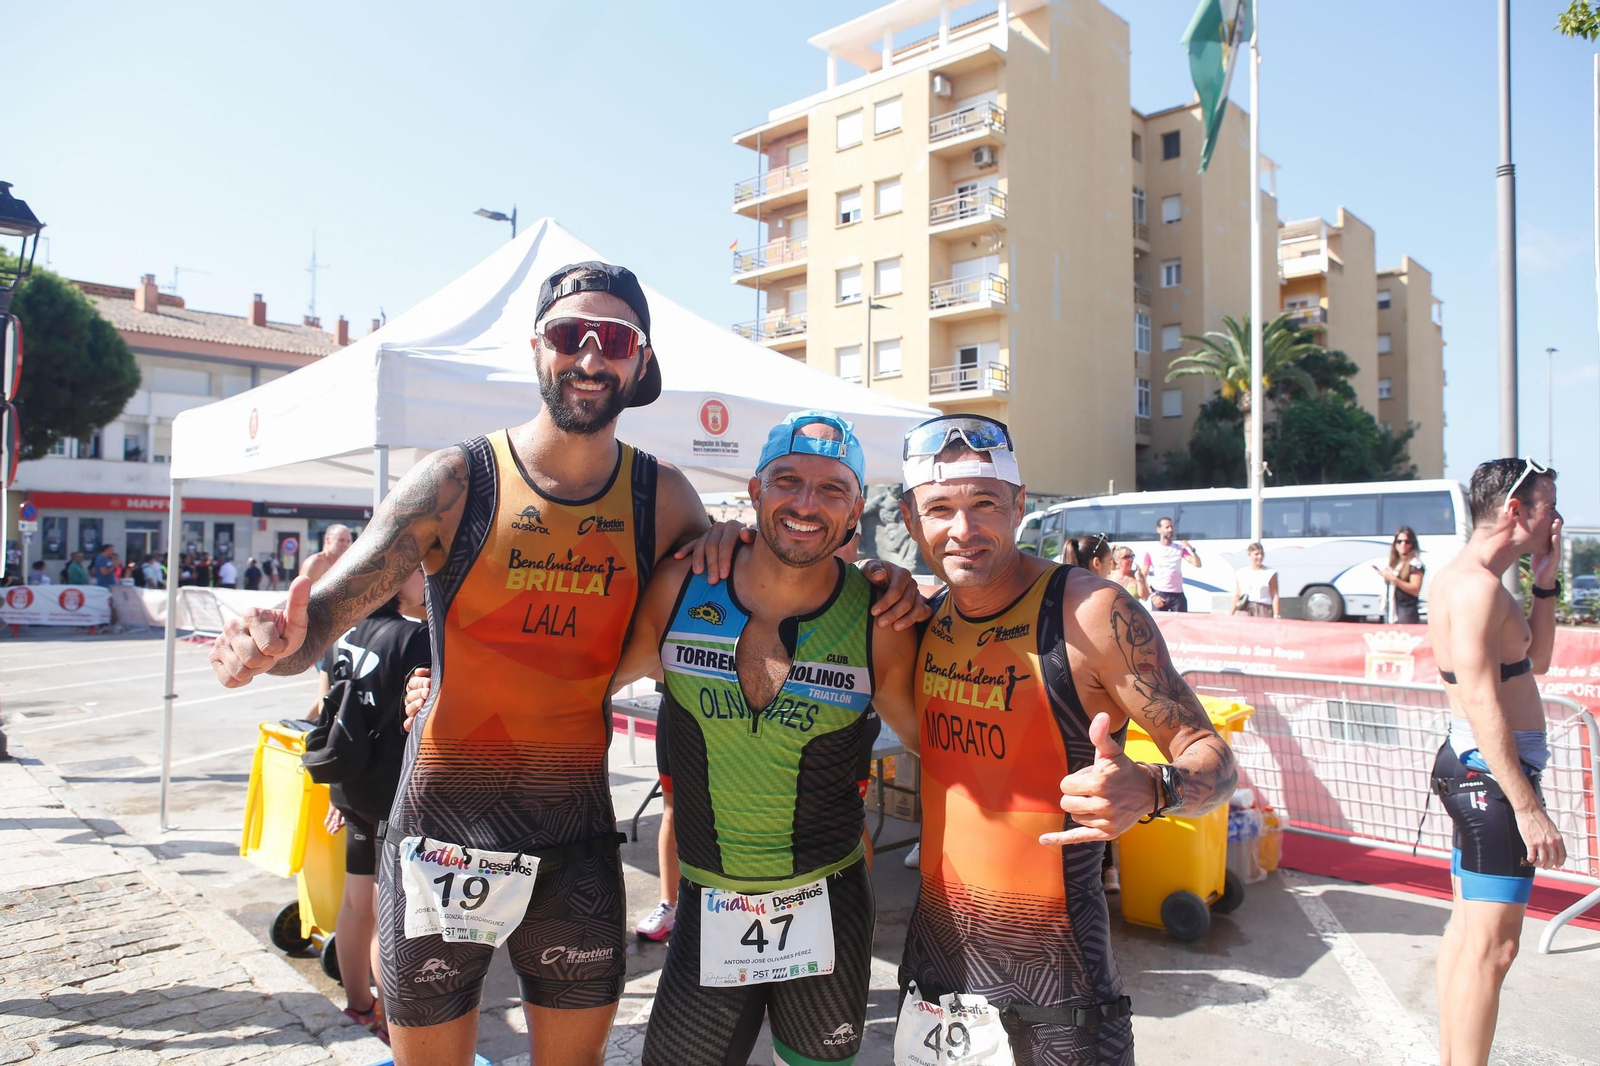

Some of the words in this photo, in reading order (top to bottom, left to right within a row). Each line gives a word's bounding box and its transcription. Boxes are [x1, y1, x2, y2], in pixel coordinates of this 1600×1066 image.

[126, 498, 185, 511] MAPF
[505, 570, 605, 596] BRILLA
[521, 603, 576, 638] LALA
[826, 653, 849, 665] CLUB
[808, 687, 852, 704] TRIATLÓN
[922, 672, 1006, 711] BRILLA
[925, 709, 1006, 760] MORATO
[433, 871, 490, 911] 19
[444, 913, 470, 921] GONZALZ
[740, 913, 794, 954] 47
[767, 953, 794, 963] OLIVARES
[752, 969, 770, 980] PST
[924, 1022, 971, 1062] 49
